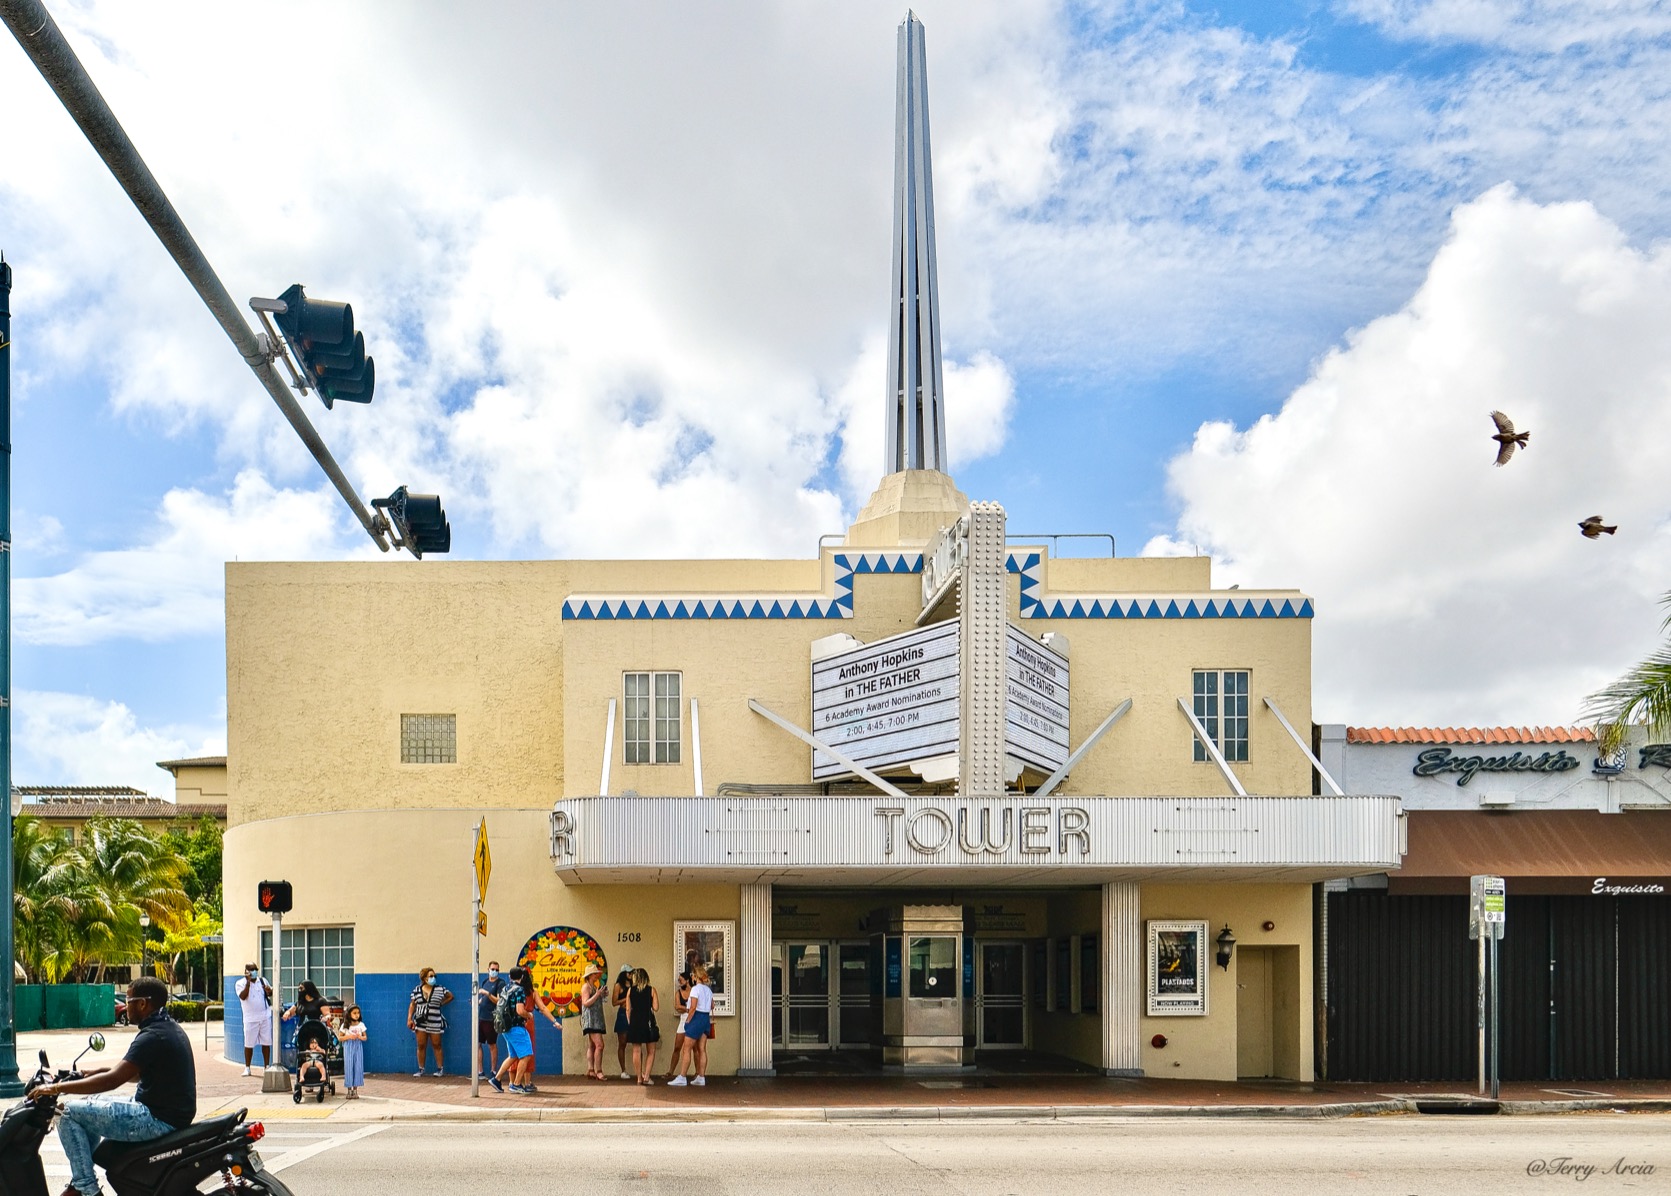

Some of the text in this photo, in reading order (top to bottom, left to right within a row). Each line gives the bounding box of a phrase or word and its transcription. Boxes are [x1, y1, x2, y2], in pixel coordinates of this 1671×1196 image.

[839, 647, 924, 680] Anthony Hopkins
[845, 668, 921, 699] in THE FATHER
[1026, 671, 1036, 687] THE
[1036, 676, 1055, 697] FATHER
[825, 688, 941, 722] 6 Academy Award Nominations
[846, 725, 865, 737] 2:00,
[888, 716, 906, 727] 7:00
[908, 712, 920, 722] PM
[1413, 748, 1580, 786] Exquisito
[874, 807, 1090, 854] TOWER
[1591, 877, 1664, 895] Exquisito
[617, 932, 642, 943] 1508
[539, 954, 580, 967] Calle 8
[541, 973, 582, 990] Miami
